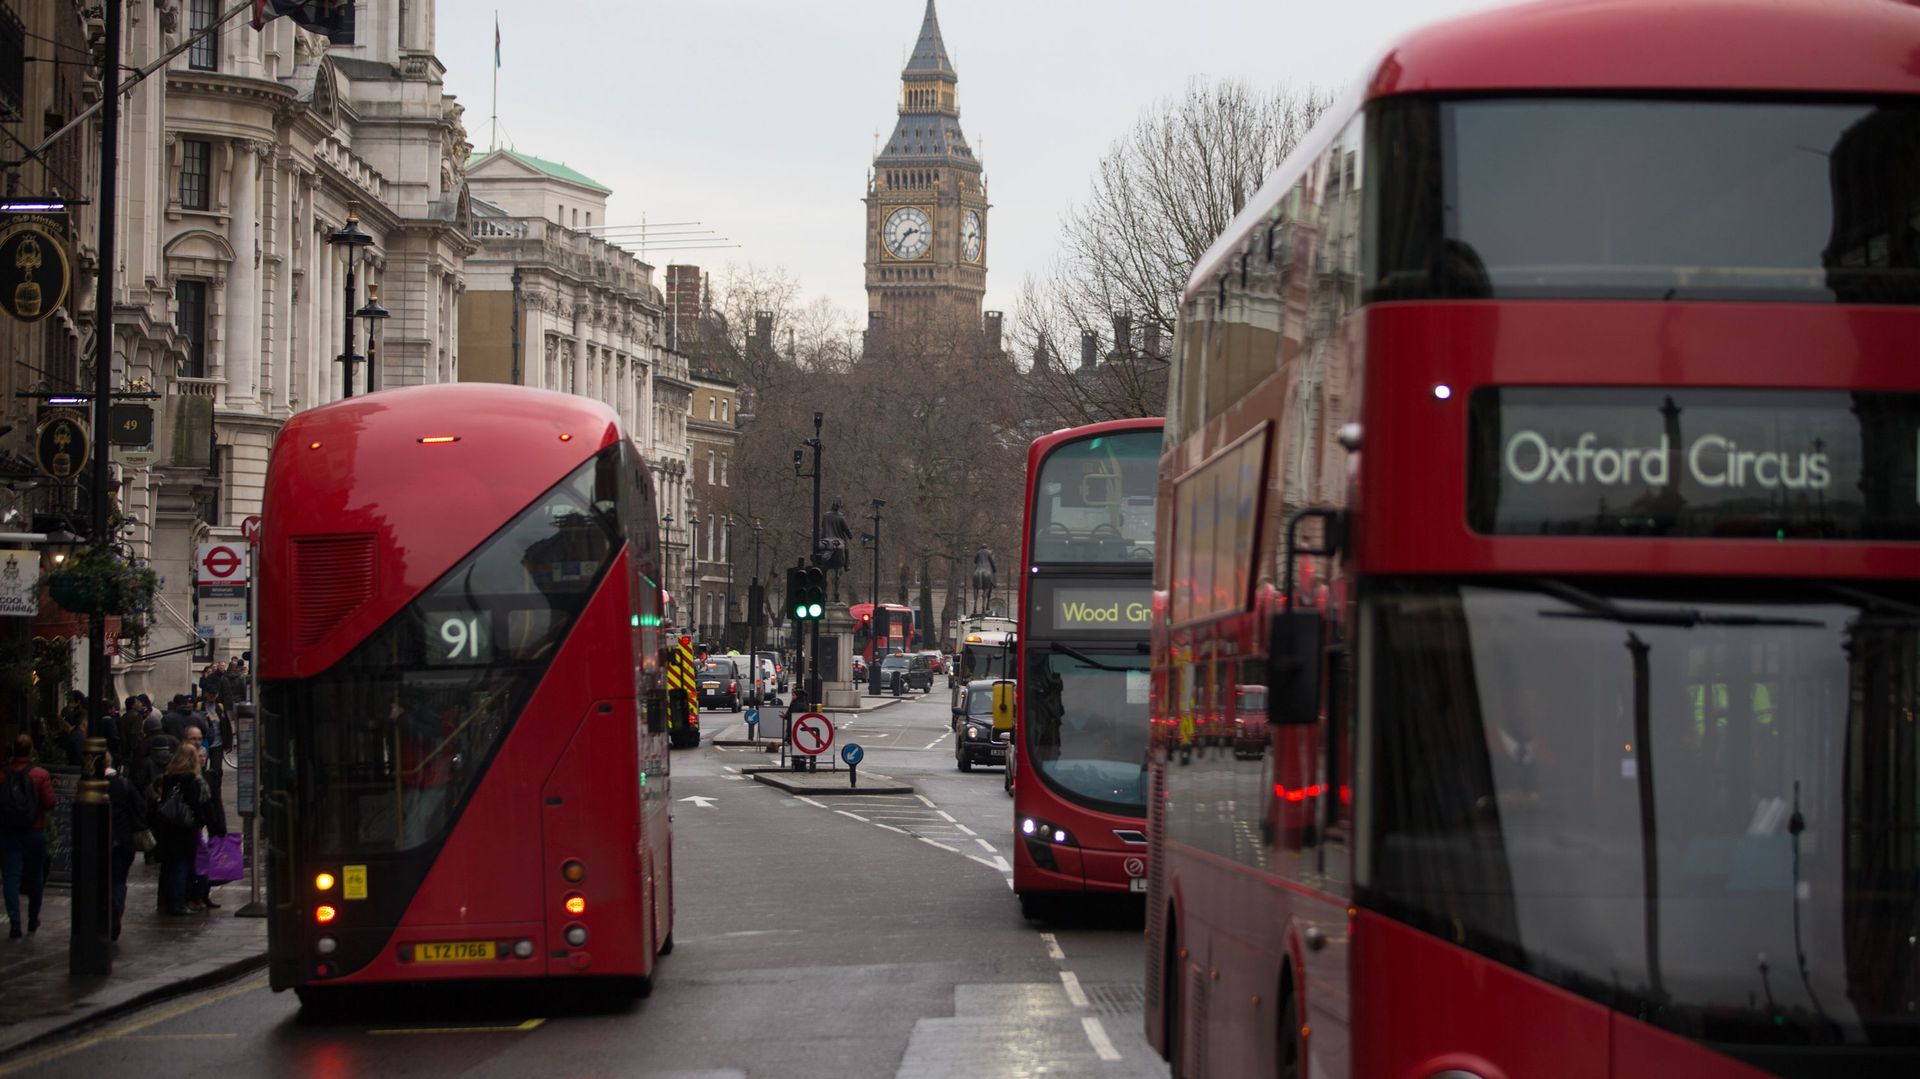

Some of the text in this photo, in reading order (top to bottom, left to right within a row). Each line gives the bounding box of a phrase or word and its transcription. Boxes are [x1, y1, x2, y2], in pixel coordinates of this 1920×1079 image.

[122, 419, 139, 431] 49
[1506, 430, 1831, 489] Oxford Circus
[244, 518, 262, 538] M
[1062, 602, 1152, 622] Wood Gr
[440, 617, 478, 659] 91
[423, 943, 487, 960] LTZ 1766
